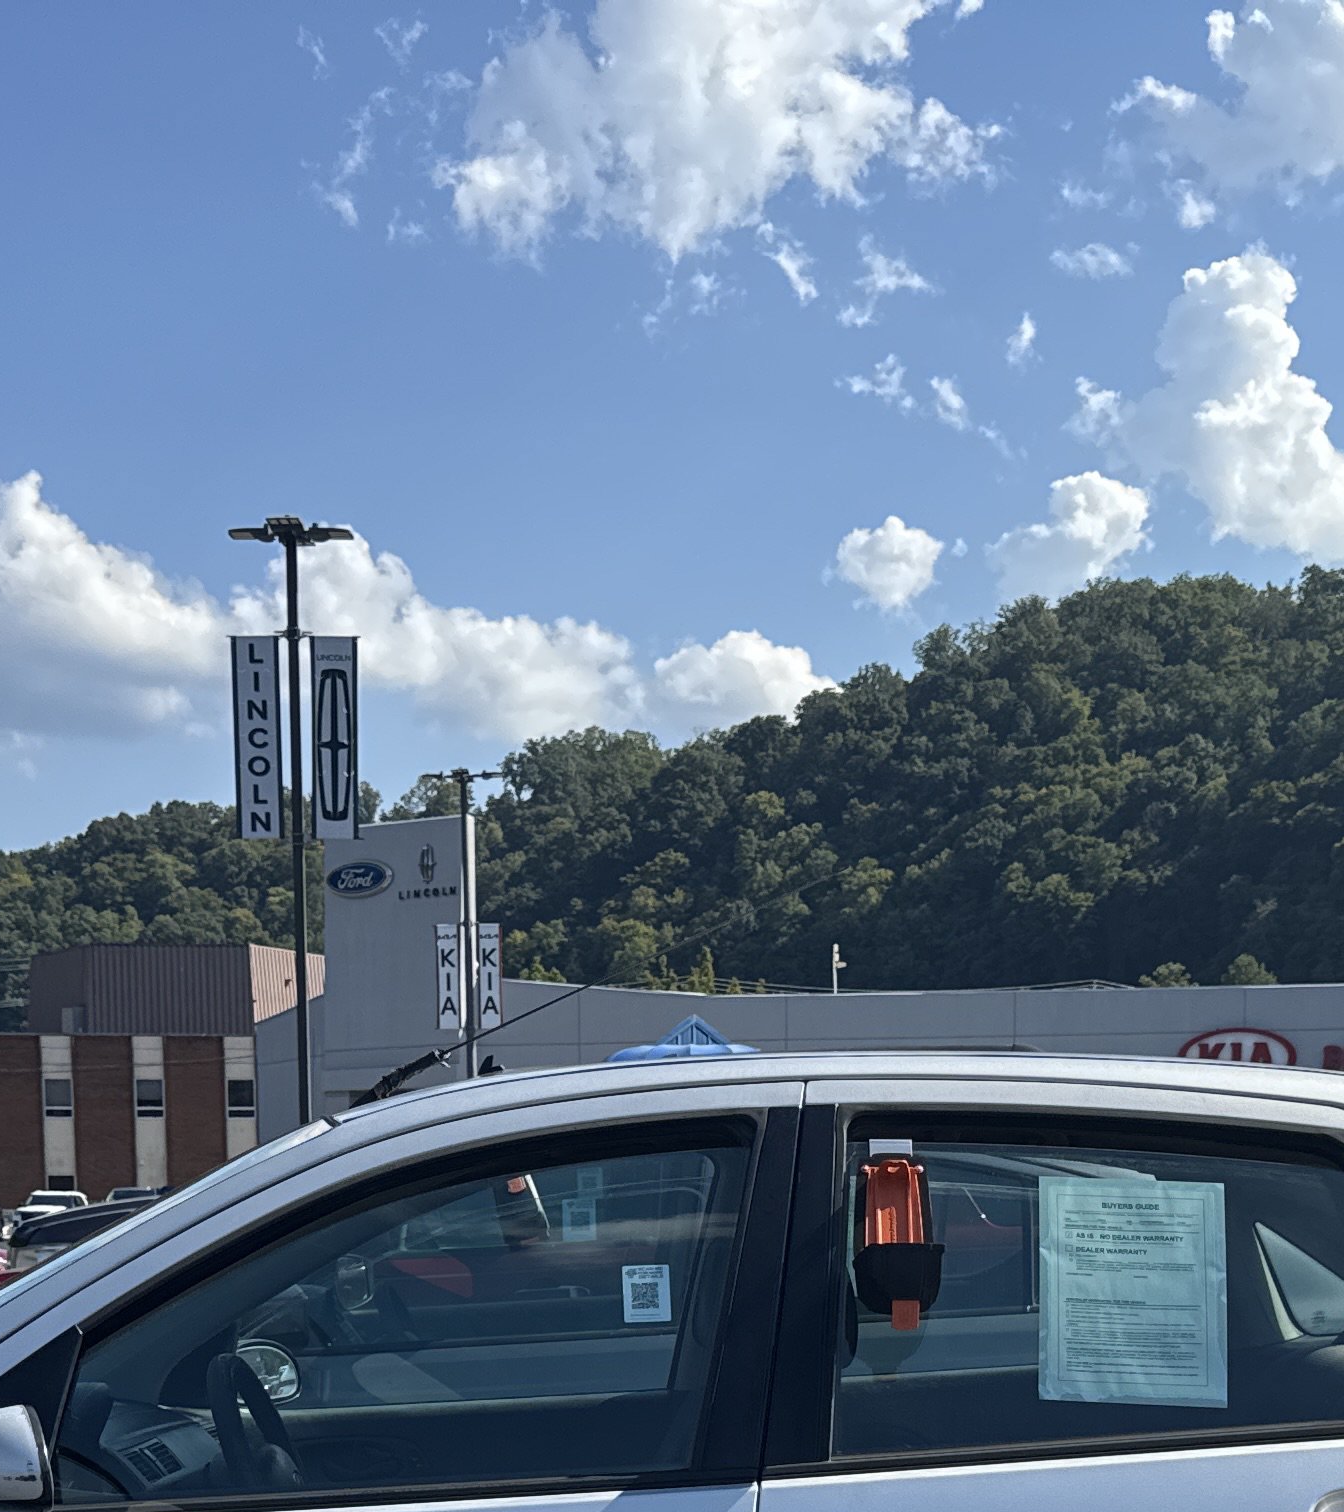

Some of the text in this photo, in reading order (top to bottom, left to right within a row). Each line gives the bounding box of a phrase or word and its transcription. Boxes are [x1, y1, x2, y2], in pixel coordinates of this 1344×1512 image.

[247, 643, 271, 832] LINCOLN
[337, 868, 374, 890] Ford
[398, 886, 457, 901] LINCOLN
[441, 948, 457, 1015] KIA
[482, 948, 499, 1015] KIA
[1101, 1202, 1160, 1211] BUYERS GUIDE
